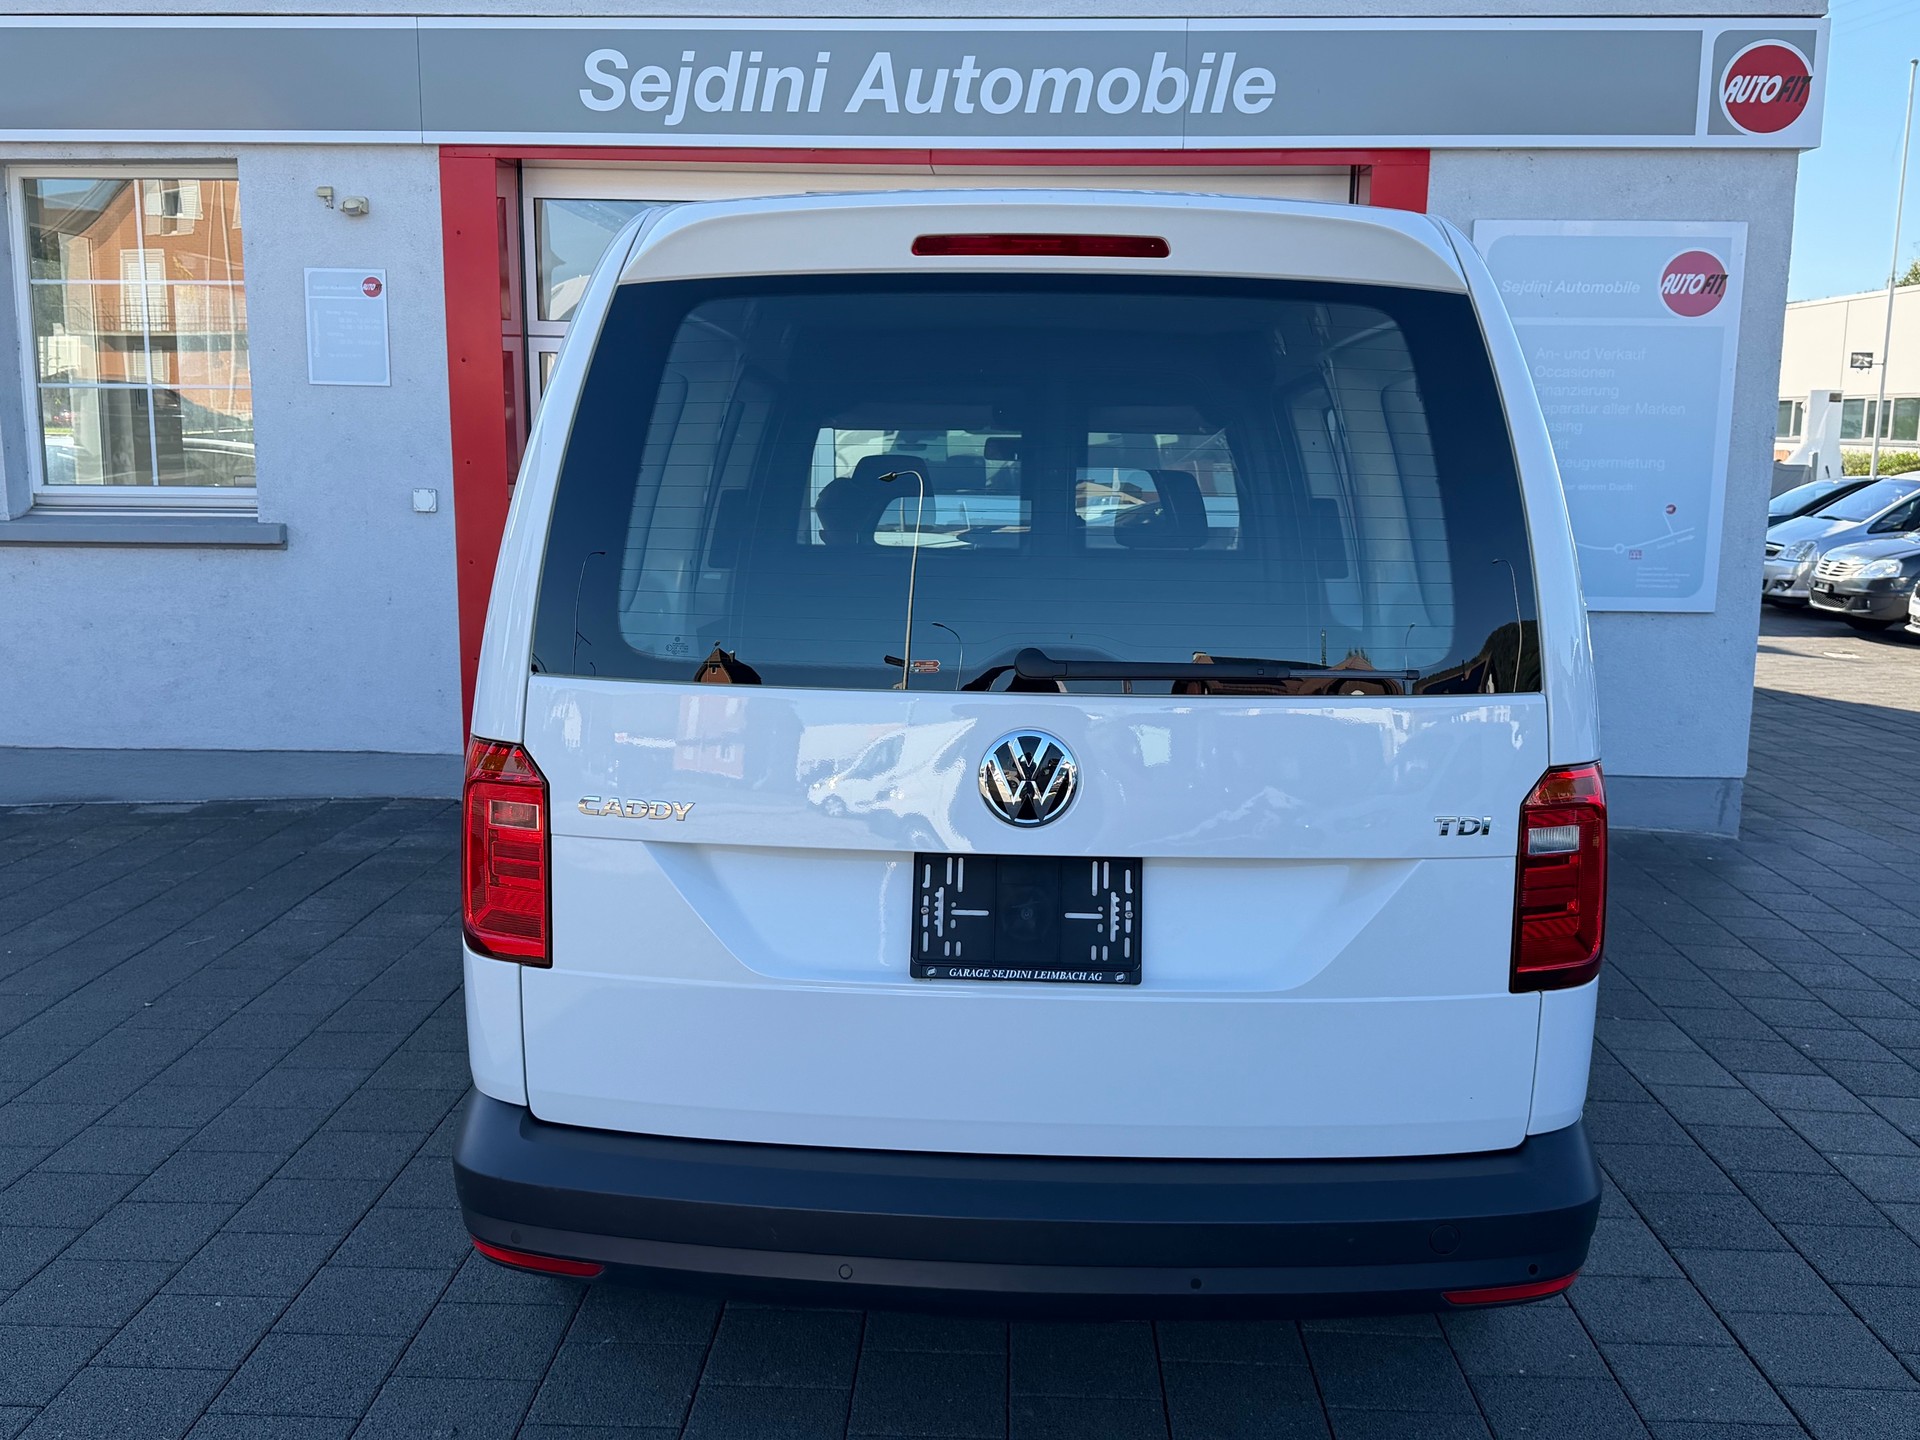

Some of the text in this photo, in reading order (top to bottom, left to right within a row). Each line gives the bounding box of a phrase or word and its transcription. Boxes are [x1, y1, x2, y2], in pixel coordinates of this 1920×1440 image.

[578, 48, 1278, 126] Sejdini Automobile
[1723, 75, 1813, 104] AUTOFIT
[1501, 280, 1641, 296] Sejdini Automobile
[1661, 273, 1728, 295] AUTOFIT
[1564, 348, 1590, 360] und
[1594, 347, 1648, 361] Verkauf
[1534, 365, 1615, 378] Occasionen
[1542, 402, 1686, 417] eparatur aller Marken
[1548, 421, 1583, 435] asing
[1558, 456, 1666, 471] zeugvermietung
[577, 795, 696, 822] CADDY
[1433, 815, 1492, 836] TDI
[949, 967, 1103, 981] GARAGE SEJDINI LEIMBACH AG
